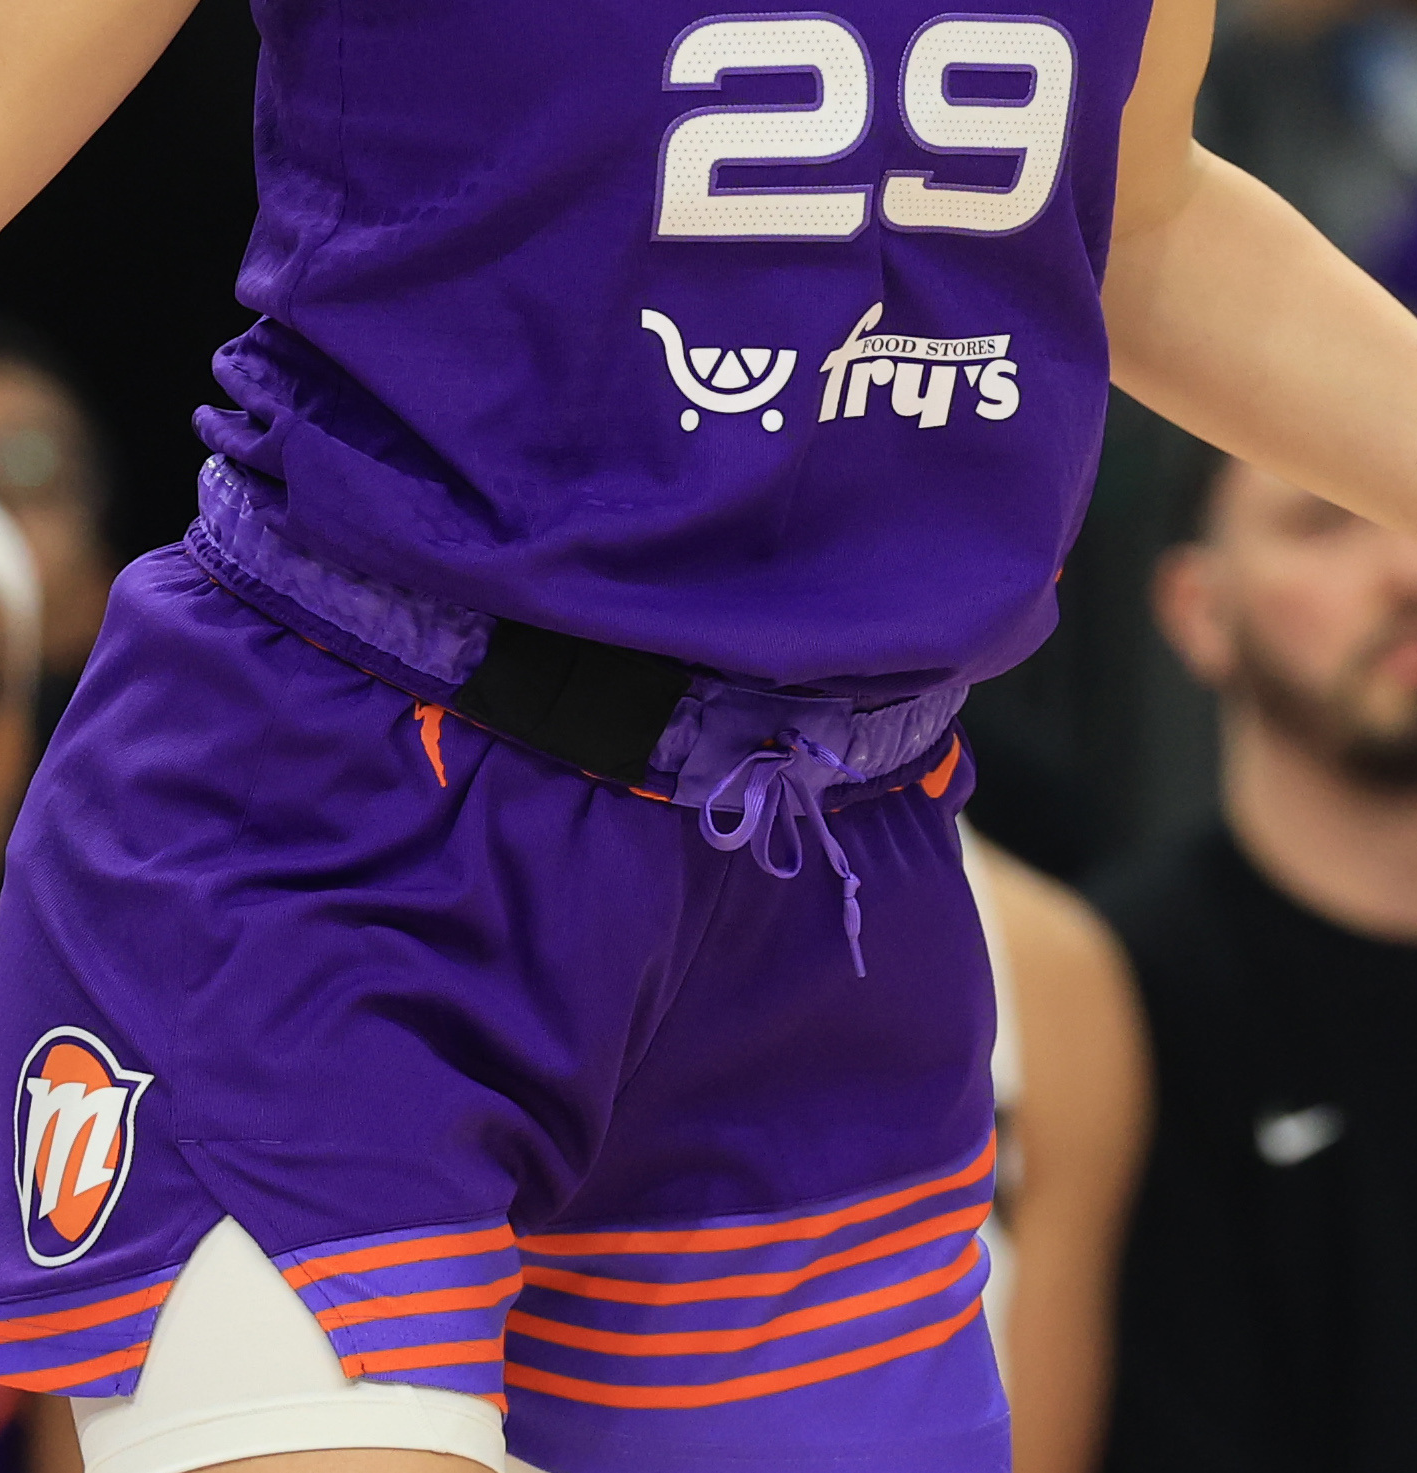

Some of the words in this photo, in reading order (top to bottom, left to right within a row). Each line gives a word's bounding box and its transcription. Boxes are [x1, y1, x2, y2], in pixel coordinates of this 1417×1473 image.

[650, 11, 1079, 243] 29
[818, 301, 1020, 428] fry's
[861, 339, 916, 355] FOOD
[925, 339, 996, 357] STORES
